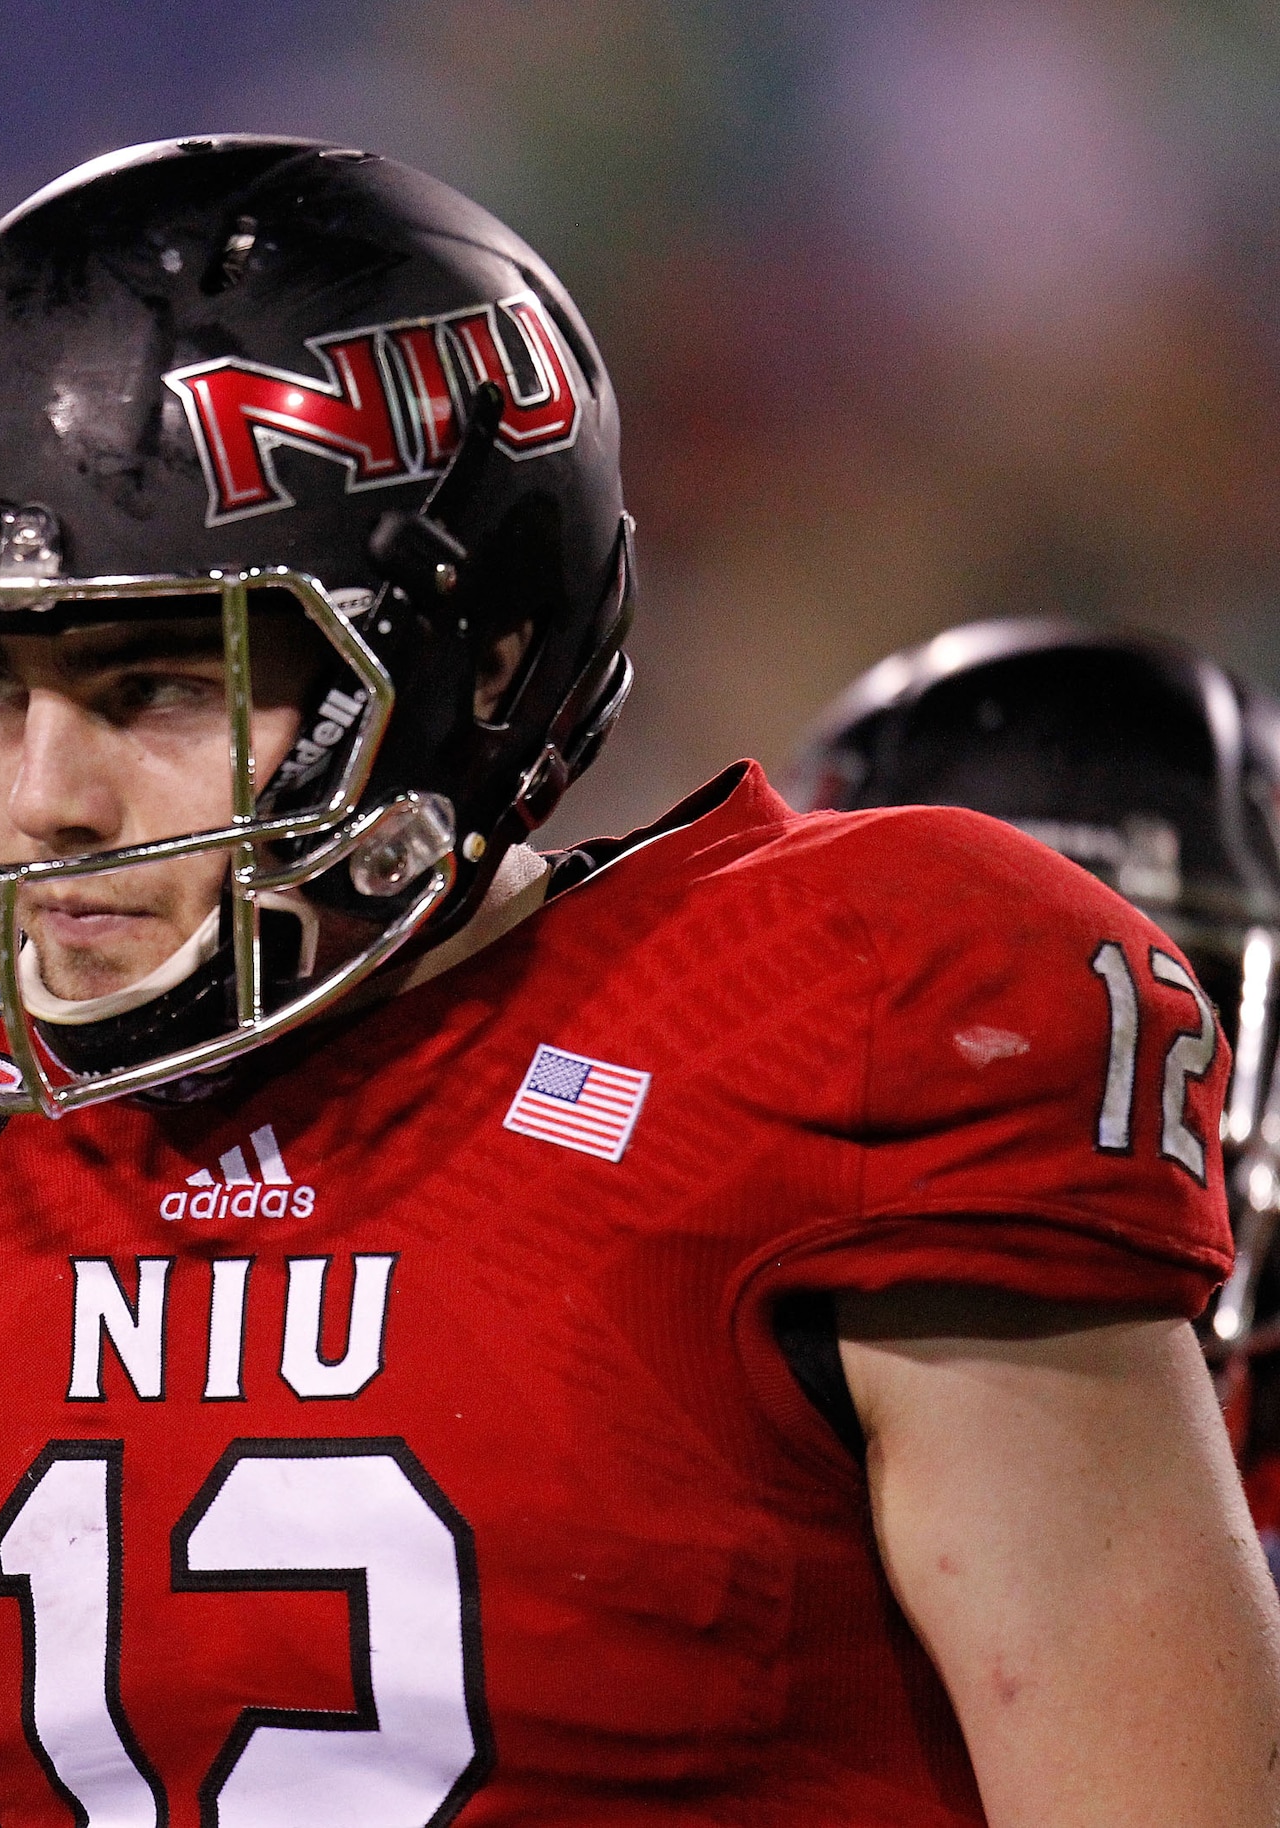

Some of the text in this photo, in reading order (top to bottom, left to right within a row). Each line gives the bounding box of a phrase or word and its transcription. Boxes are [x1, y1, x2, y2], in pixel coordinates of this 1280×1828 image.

[161, 290, 582, 528] NIU
[1091, 940, 1218, 1188] 12
[160, 1182, 316, 1221] adidas
[66, 1253, 398, 1400] NIU
